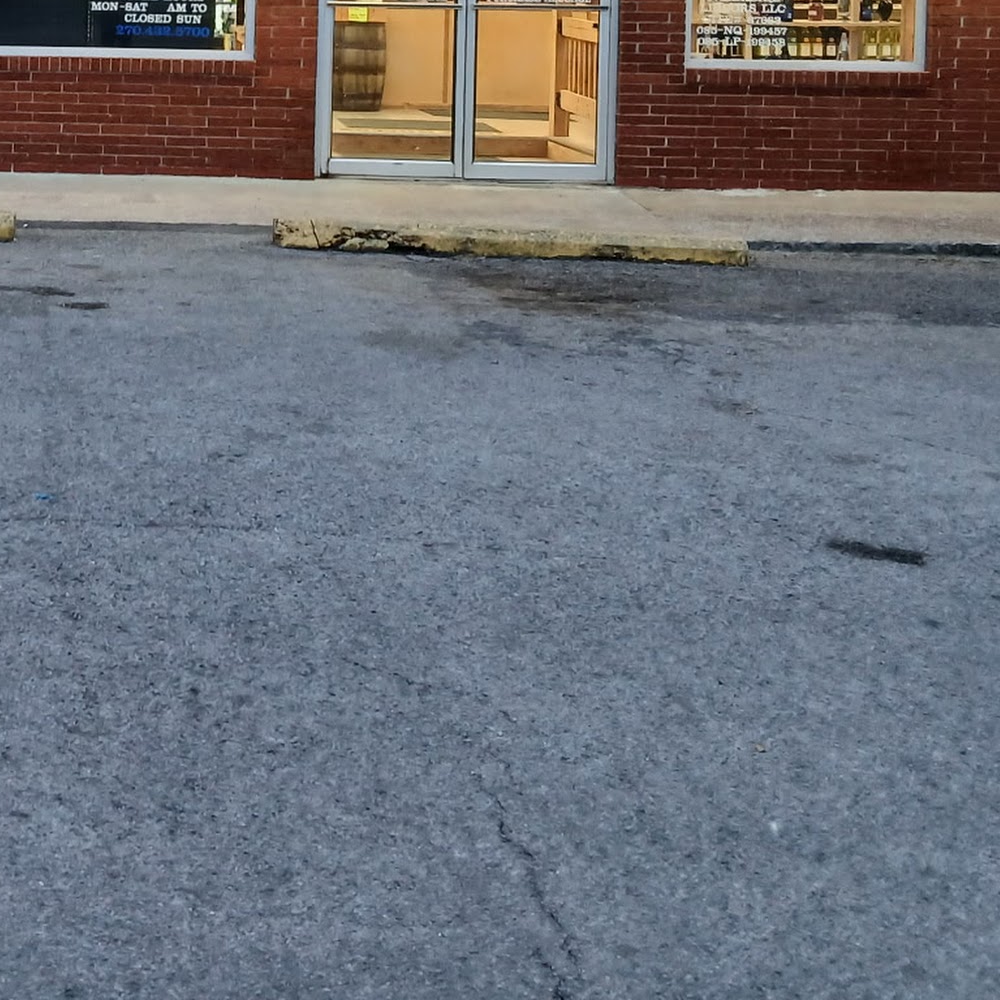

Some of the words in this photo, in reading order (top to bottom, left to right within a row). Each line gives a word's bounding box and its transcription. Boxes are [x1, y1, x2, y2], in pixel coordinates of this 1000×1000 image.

[167, 3, 187, 13] AM
[190, 3, 207, 13] TO
[761, 4, 787, 13] LLC
[124, 13, 172, 24] CLOSED
[176, 14, 202, 25] SUN
